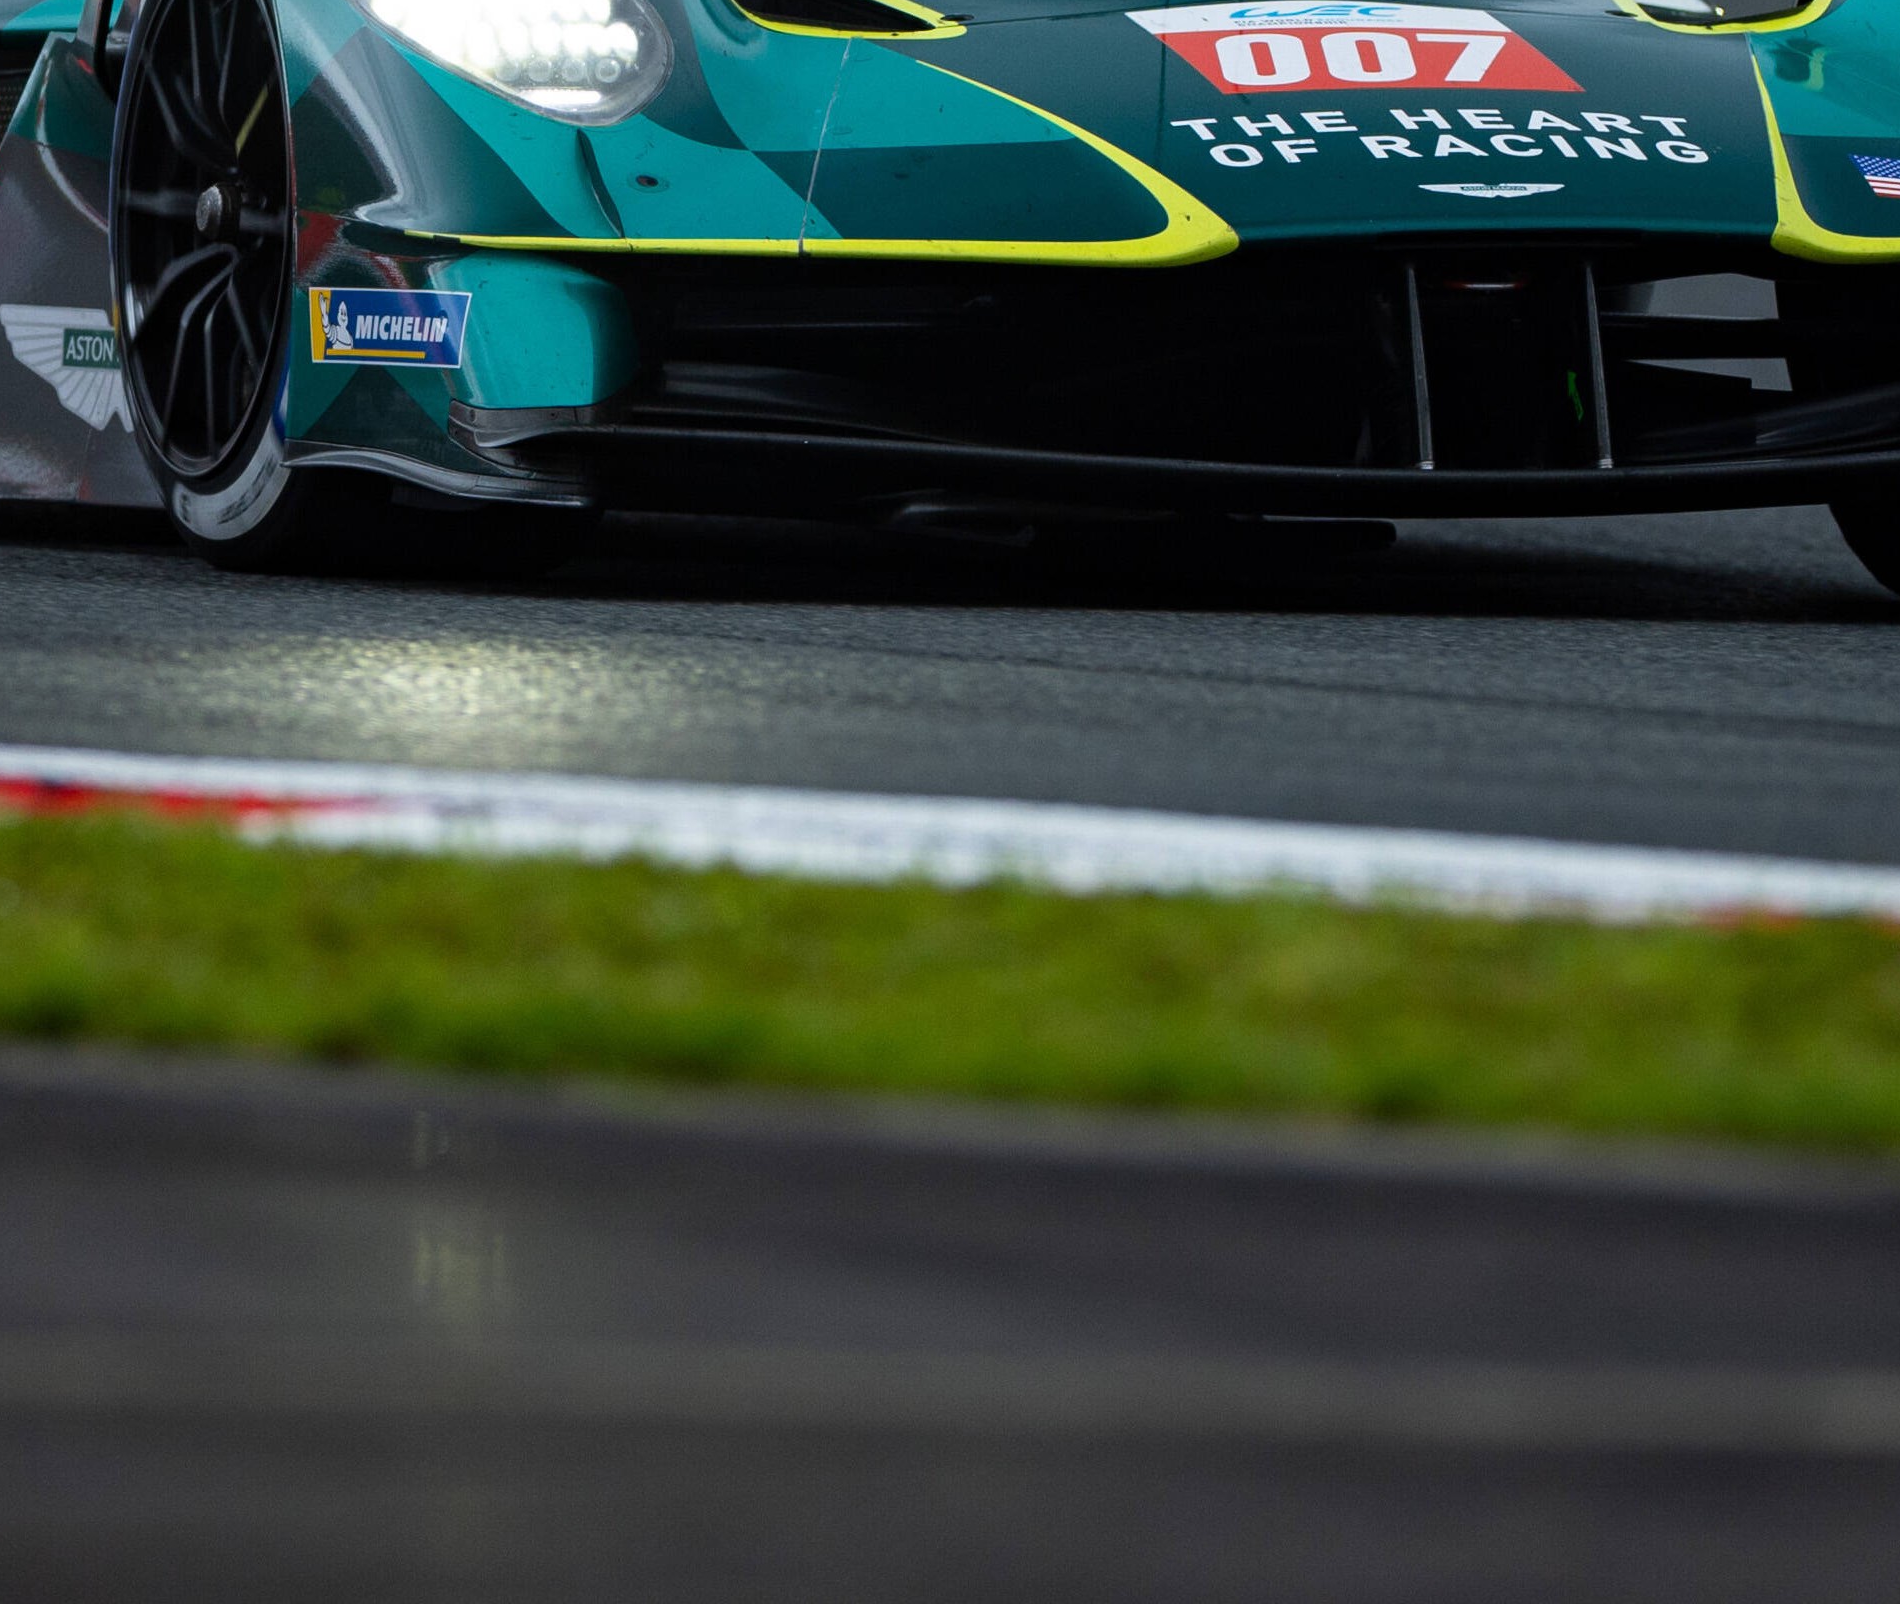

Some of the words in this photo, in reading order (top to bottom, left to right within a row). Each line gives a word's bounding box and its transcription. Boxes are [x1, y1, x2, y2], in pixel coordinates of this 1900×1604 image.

[1229, 4, 1402, 19] WEC
[1214, 31, 1507, 86] 007
[1169, 109, 1358, 141] THE
[1389, 108, 1687, 138] HEART
[1209, 138, 1319, 168] OF
[1358, 134, 1710, 164] RACING
[355, 314, 447, 343] MICHELIN
[65, 335, 115, 363] ASTON
